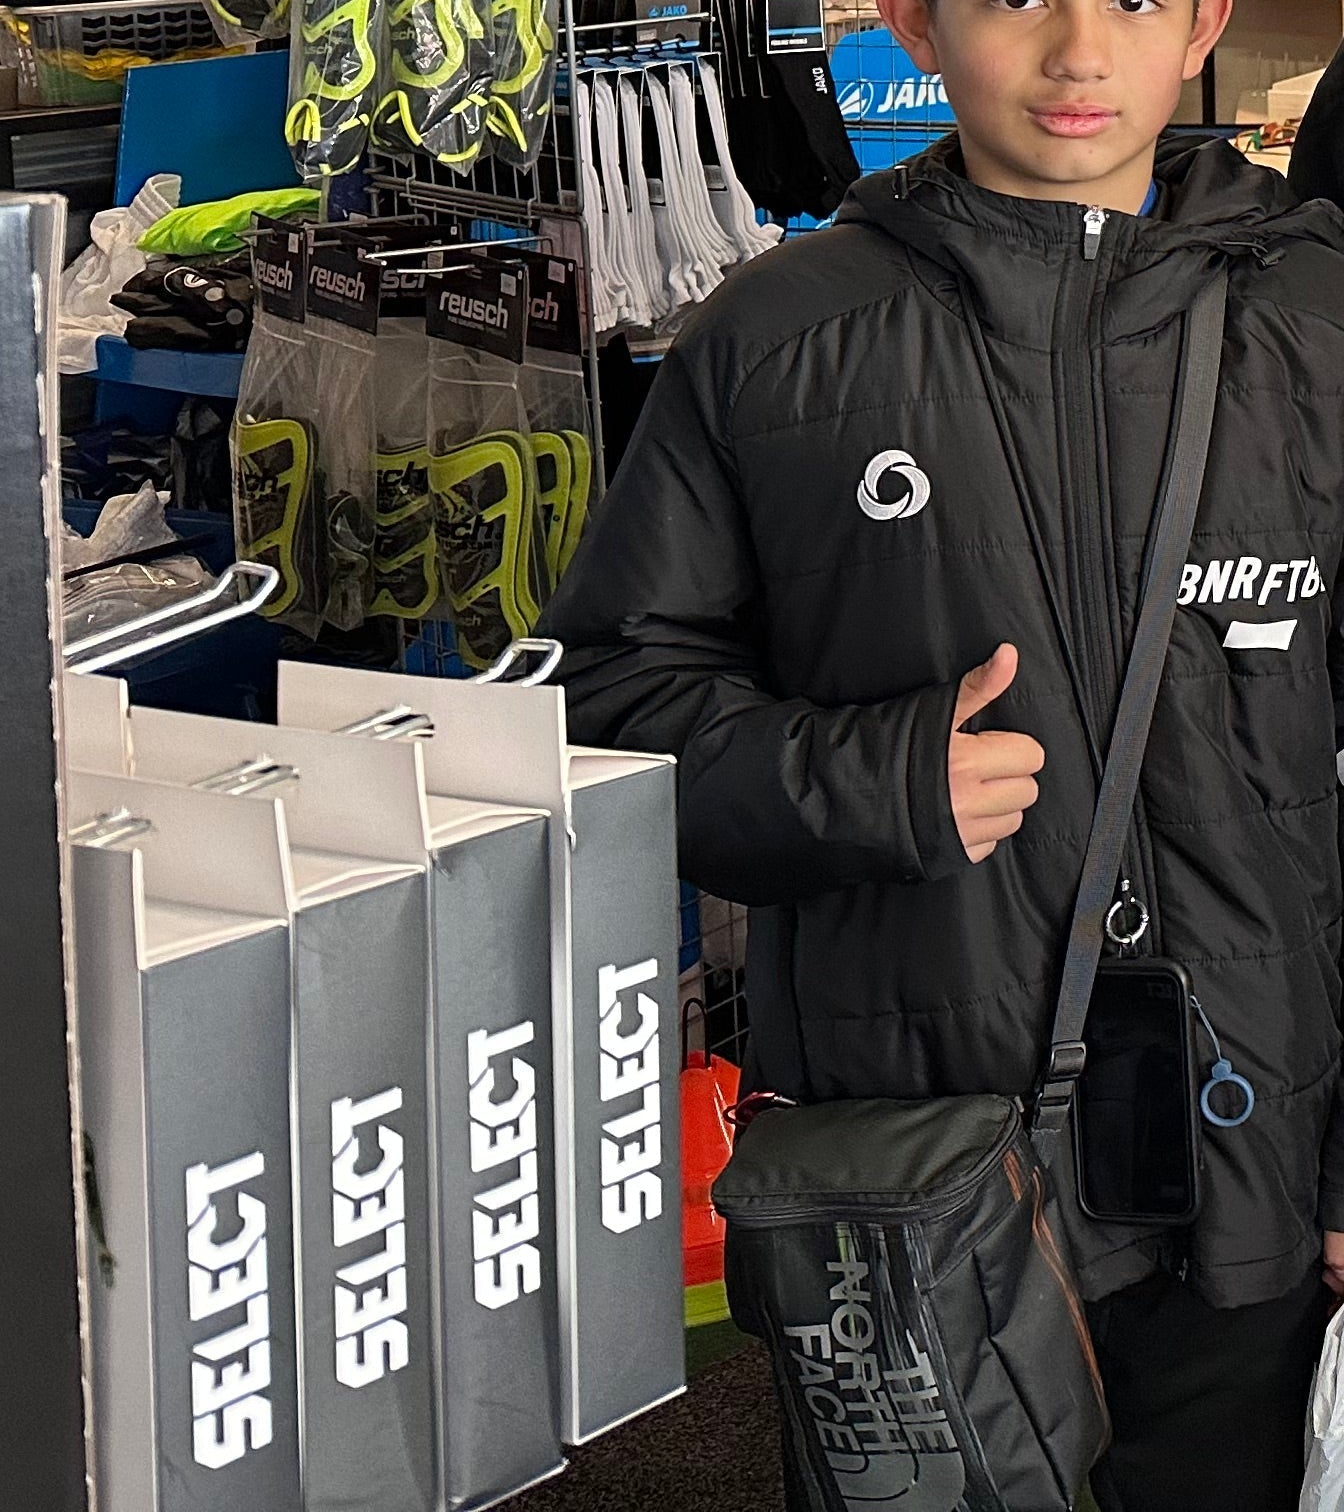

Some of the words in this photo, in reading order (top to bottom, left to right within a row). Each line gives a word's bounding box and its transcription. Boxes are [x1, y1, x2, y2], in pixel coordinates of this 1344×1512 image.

[661, 4, 688, 16] JAKO
[811, 67, 828, 94] JAKO
[309, 265, 366, 302] reusch
[439, 291, 509, 329] reusch
[1176, 556, 1326, 606] BNRFTB
[598, 958, 663, 1234] SELECT
[467, 1021, 541, 1310] SELECT
[331, 1086, 409, 1389] SELECT
[185, 1150, 273, 1469] SELECT
[826, 1261, 906, 1453] NORTH
[784, 1323, 863, 1452] FACE
[883, 1351, 958, 1450] THE
